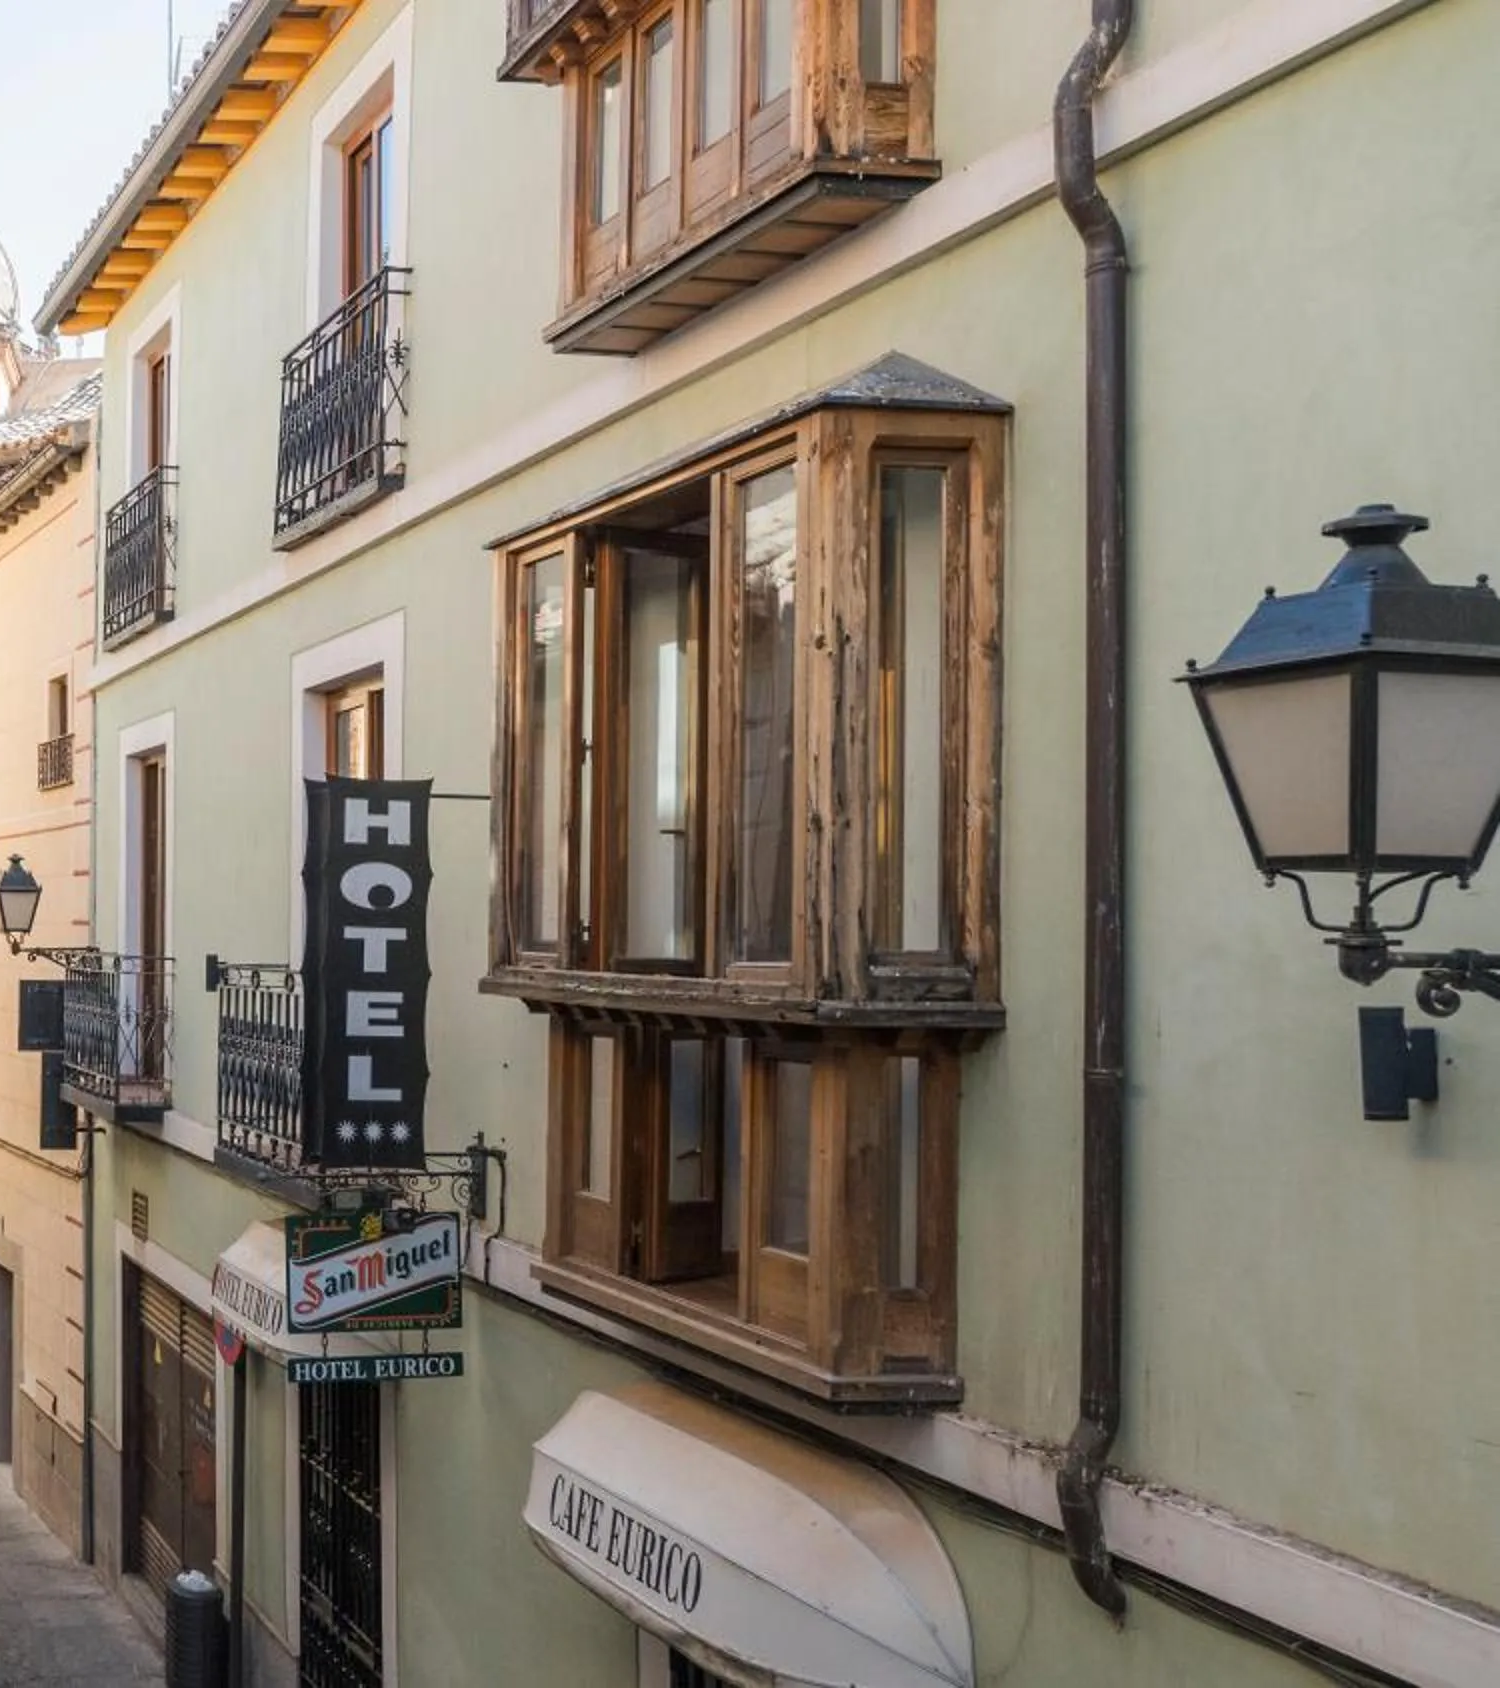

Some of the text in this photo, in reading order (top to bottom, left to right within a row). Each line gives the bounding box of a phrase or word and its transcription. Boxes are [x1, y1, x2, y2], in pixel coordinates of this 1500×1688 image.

[340, 797, 413, 1102] HOTEL
[295, 1356, 455, 1382] HOTEL EURICO
[550, 1474, 702, 1613] CAFE EURICO
